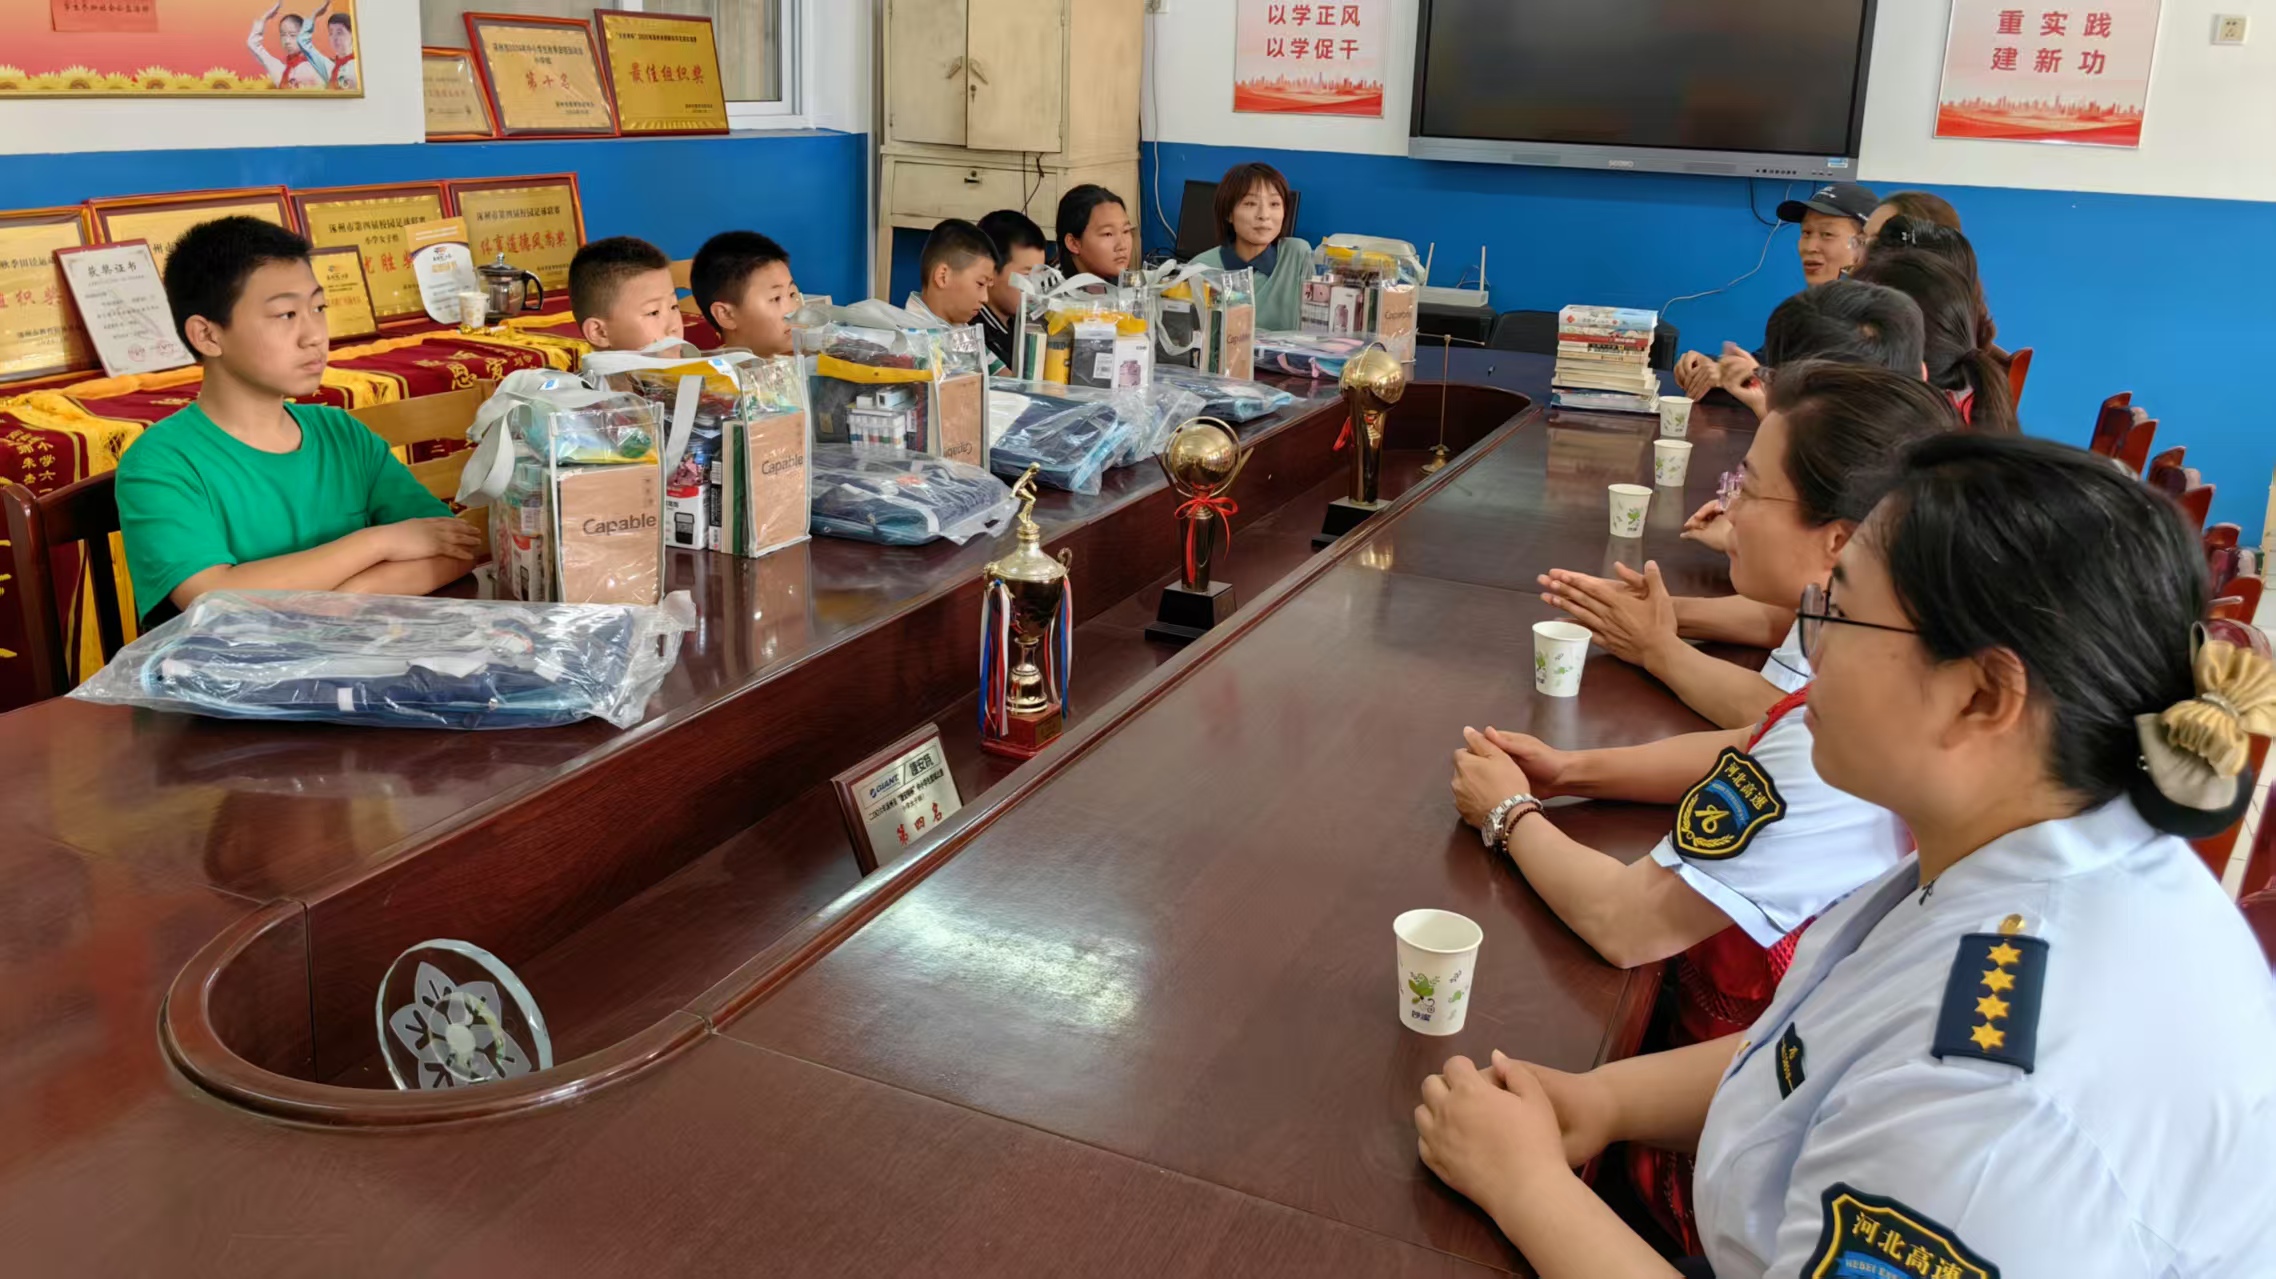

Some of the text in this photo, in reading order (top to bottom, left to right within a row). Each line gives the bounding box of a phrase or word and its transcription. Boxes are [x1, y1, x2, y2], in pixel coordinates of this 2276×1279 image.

[1268, 4, 1360, 27] 以学正风
[1997, 10, 2112, 38] 重实践
[1266, 37, 1359, 60] 以学促干
[1990, 46, 2107, 75] 建新功
[525, 71, 570, 92] 第十名
[629, 62, 704, 84] 最佳组织奖
[480, 231, 567, 255] 体育道德风尚奖
[87, 262, 137, 278] 获奖证书
[761, 452, 804, 476] Capable
[582, 512, 658, 537] Capable
[1724, 762, 1769, 810] 河北高速
[897, 802, 942, 845] 第四名
[1852, 1212, 1962, 1279] 河北高速
